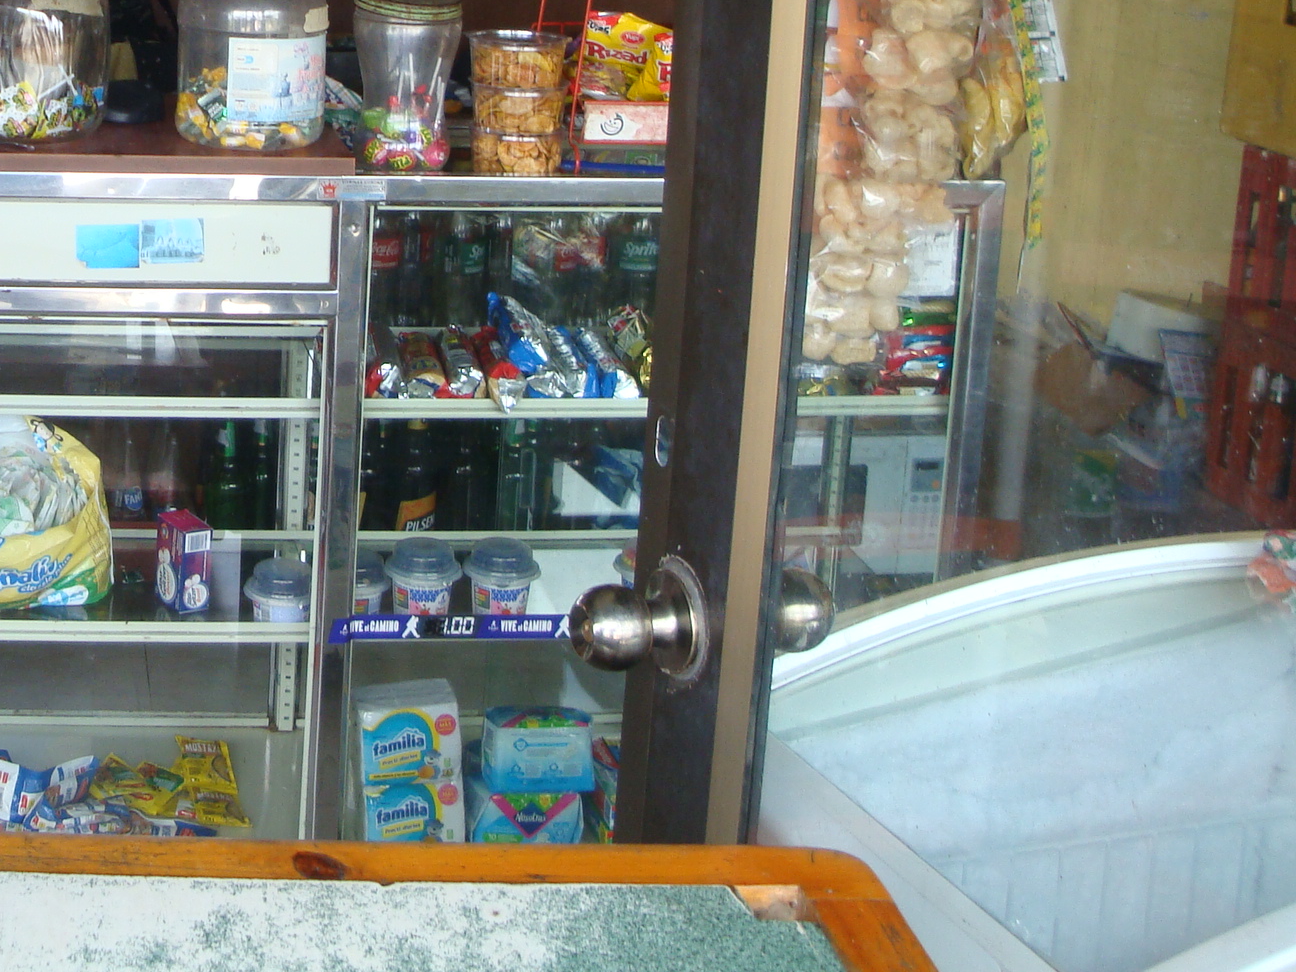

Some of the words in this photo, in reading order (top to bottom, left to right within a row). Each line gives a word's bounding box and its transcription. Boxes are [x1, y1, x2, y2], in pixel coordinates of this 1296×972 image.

[370, 620, 399, 633] CAMINO
[500, 620, 515, 632] VIVE
[523, 620, 552, 633] CAMINO
[373, 733, 425, 757] familia
[376, 801, 428, 824] familia
